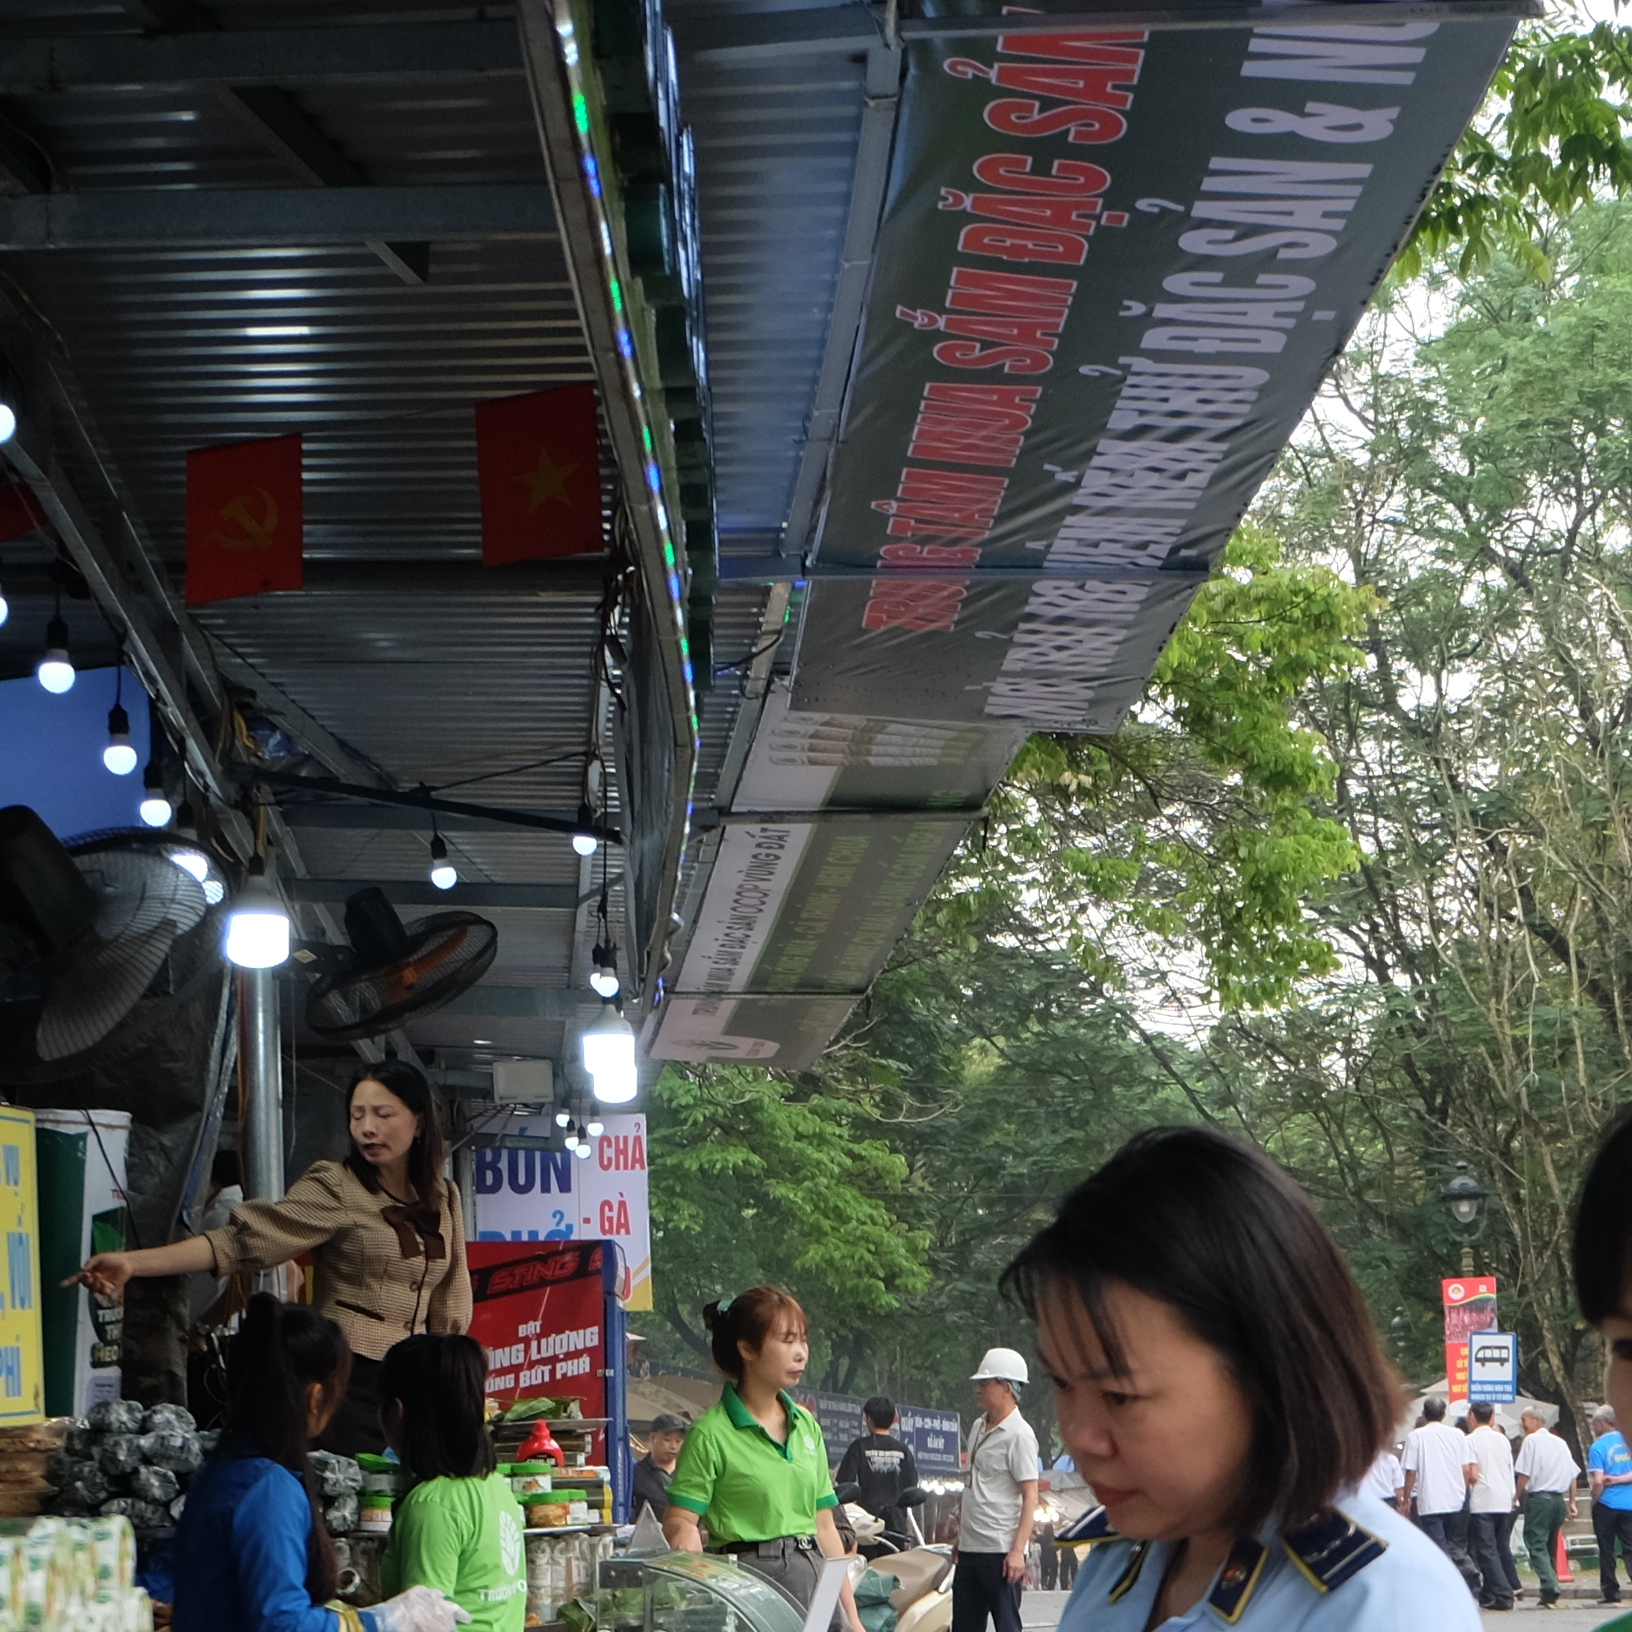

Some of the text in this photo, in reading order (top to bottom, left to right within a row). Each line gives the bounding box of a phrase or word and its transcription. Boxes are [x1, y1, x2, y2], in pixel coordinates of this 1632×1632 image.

[1225, 101, 1401, 144] &
[938, 153, 1130, 265] ĐẶC
[1135, 156, 1373, 259] SẢN
[896, 266, 1077, 374] SẮM
[1119, 271, 1336, 353] ĐẶC
[1078, 355, 1270, 429] THỬ
[907, 382, 1042, 467] MUA
[871, 467, 1009, 538] TÂM
[1043, 439, 1229, 509] NẾM
[1024, 515, 1198, 620] NGIỆM
[737, 852, 782, 882] VÙNG
[745, 827, 791, 850] ĐẤT
[730, 883, 772, 914] OCOP
[598, 1122, 646, 1171] CHẢ
[599, 1192, 633, 1237] GÀ
[487, 1252, 580, 1294] STING
[530, 1325, 599, 1361] LƯỢNG
[556, 1354, 590, 1380] PHÁ
